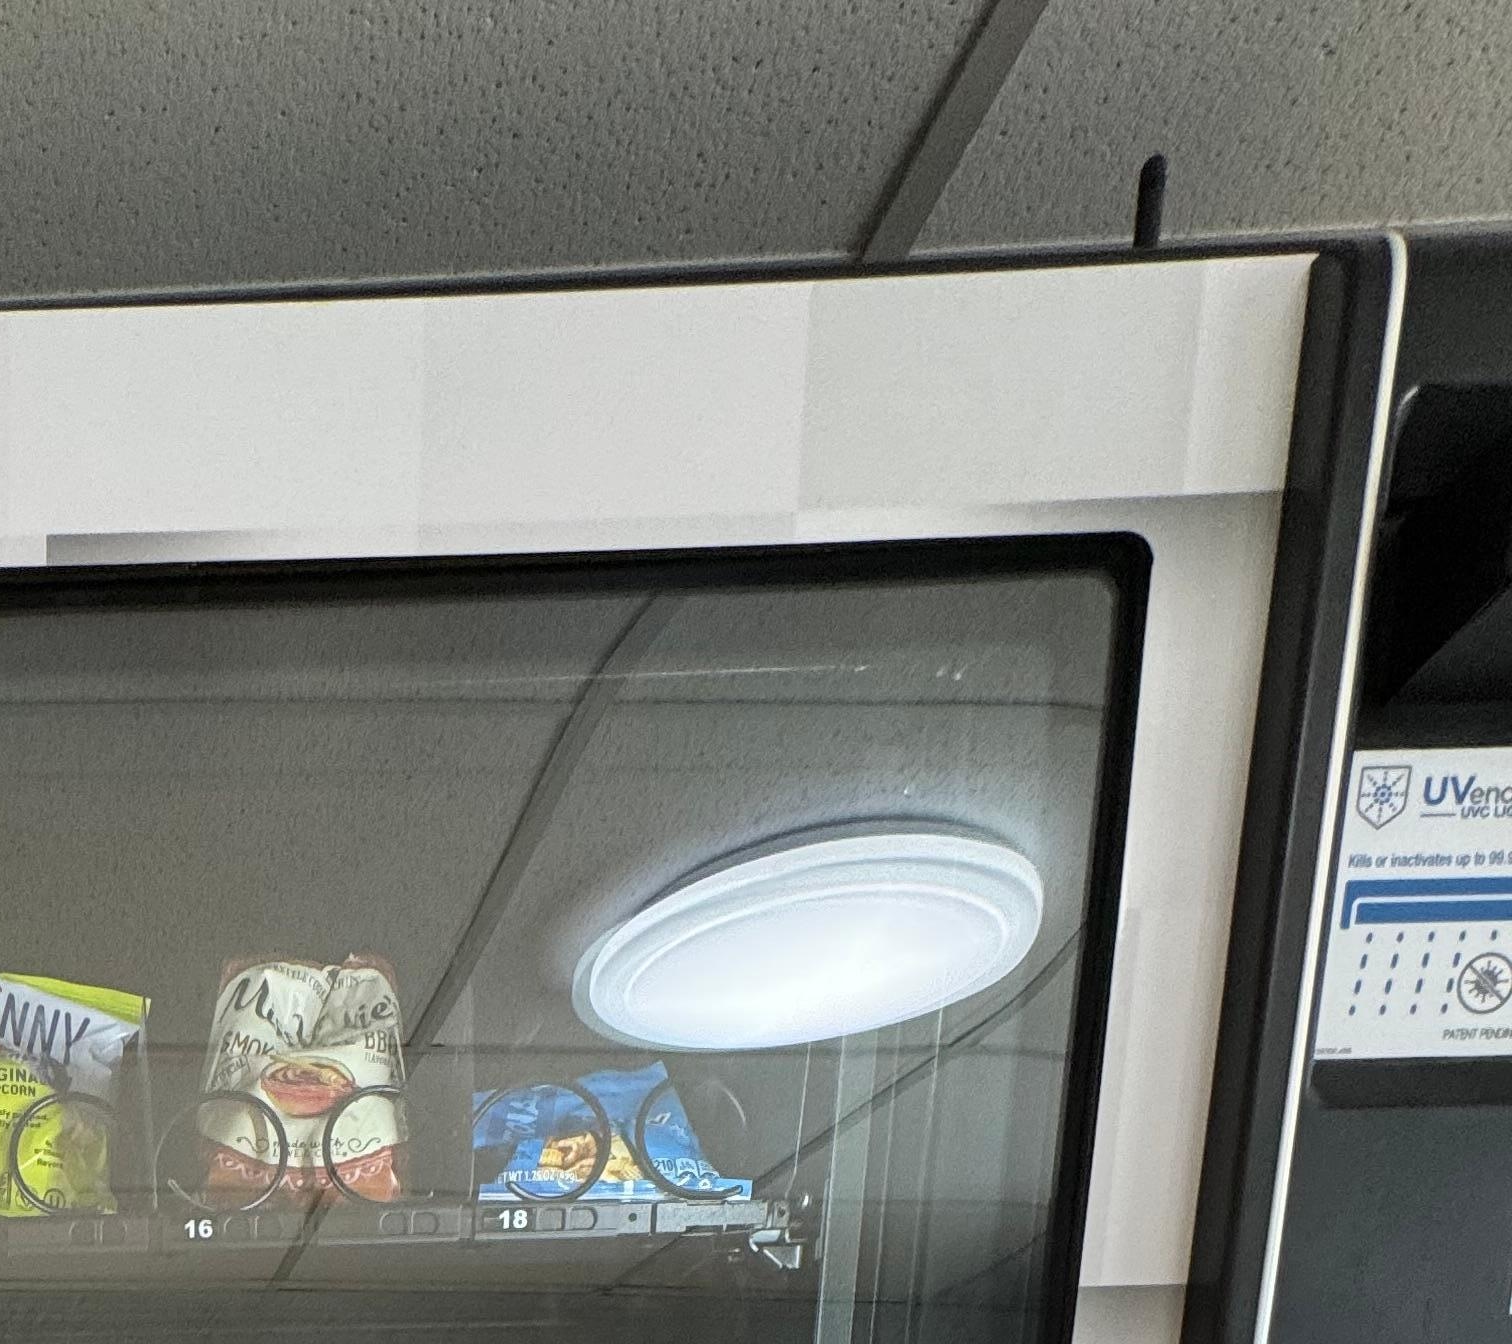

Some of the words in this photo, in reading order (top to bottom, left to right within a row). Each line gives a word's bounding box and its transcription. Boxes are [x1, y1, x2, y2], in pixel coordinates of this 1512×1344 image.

[1461, 806, 1490, 818] UVC
[1348, 853, 1372, 868] Kills
[1375, 857, 1388, 867] or
[1391, 853, 1451, 867] inactivates
[1455, 855, 1471, 868] up
[1474, 853, 1485, 865] to
[1443, 1028, 1478, 1040] PATENT
[498, 1209, 528, 1229] 18
[184, 1219, 213, 1239] 16
